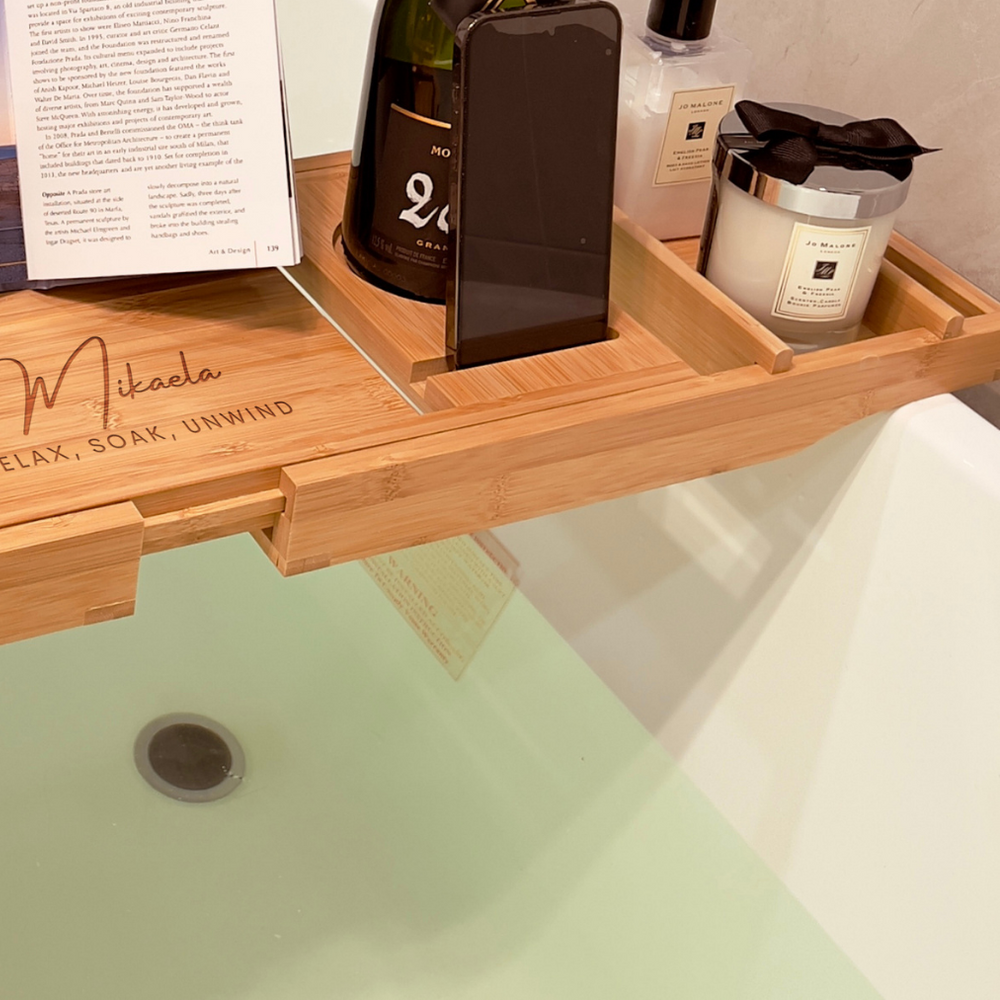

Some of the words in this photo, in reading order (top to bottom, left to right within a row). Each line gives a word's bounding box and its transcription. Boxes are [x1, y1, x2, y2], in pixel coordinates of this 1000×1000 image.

[690, 100, 723, 109] MALONE
[430, 145, 451, 158] MO
[416, 239, 448, 251] GRAN
[88, 425, 177, 453] SOAK,
[182, 400, 294, 434] UNWIND
